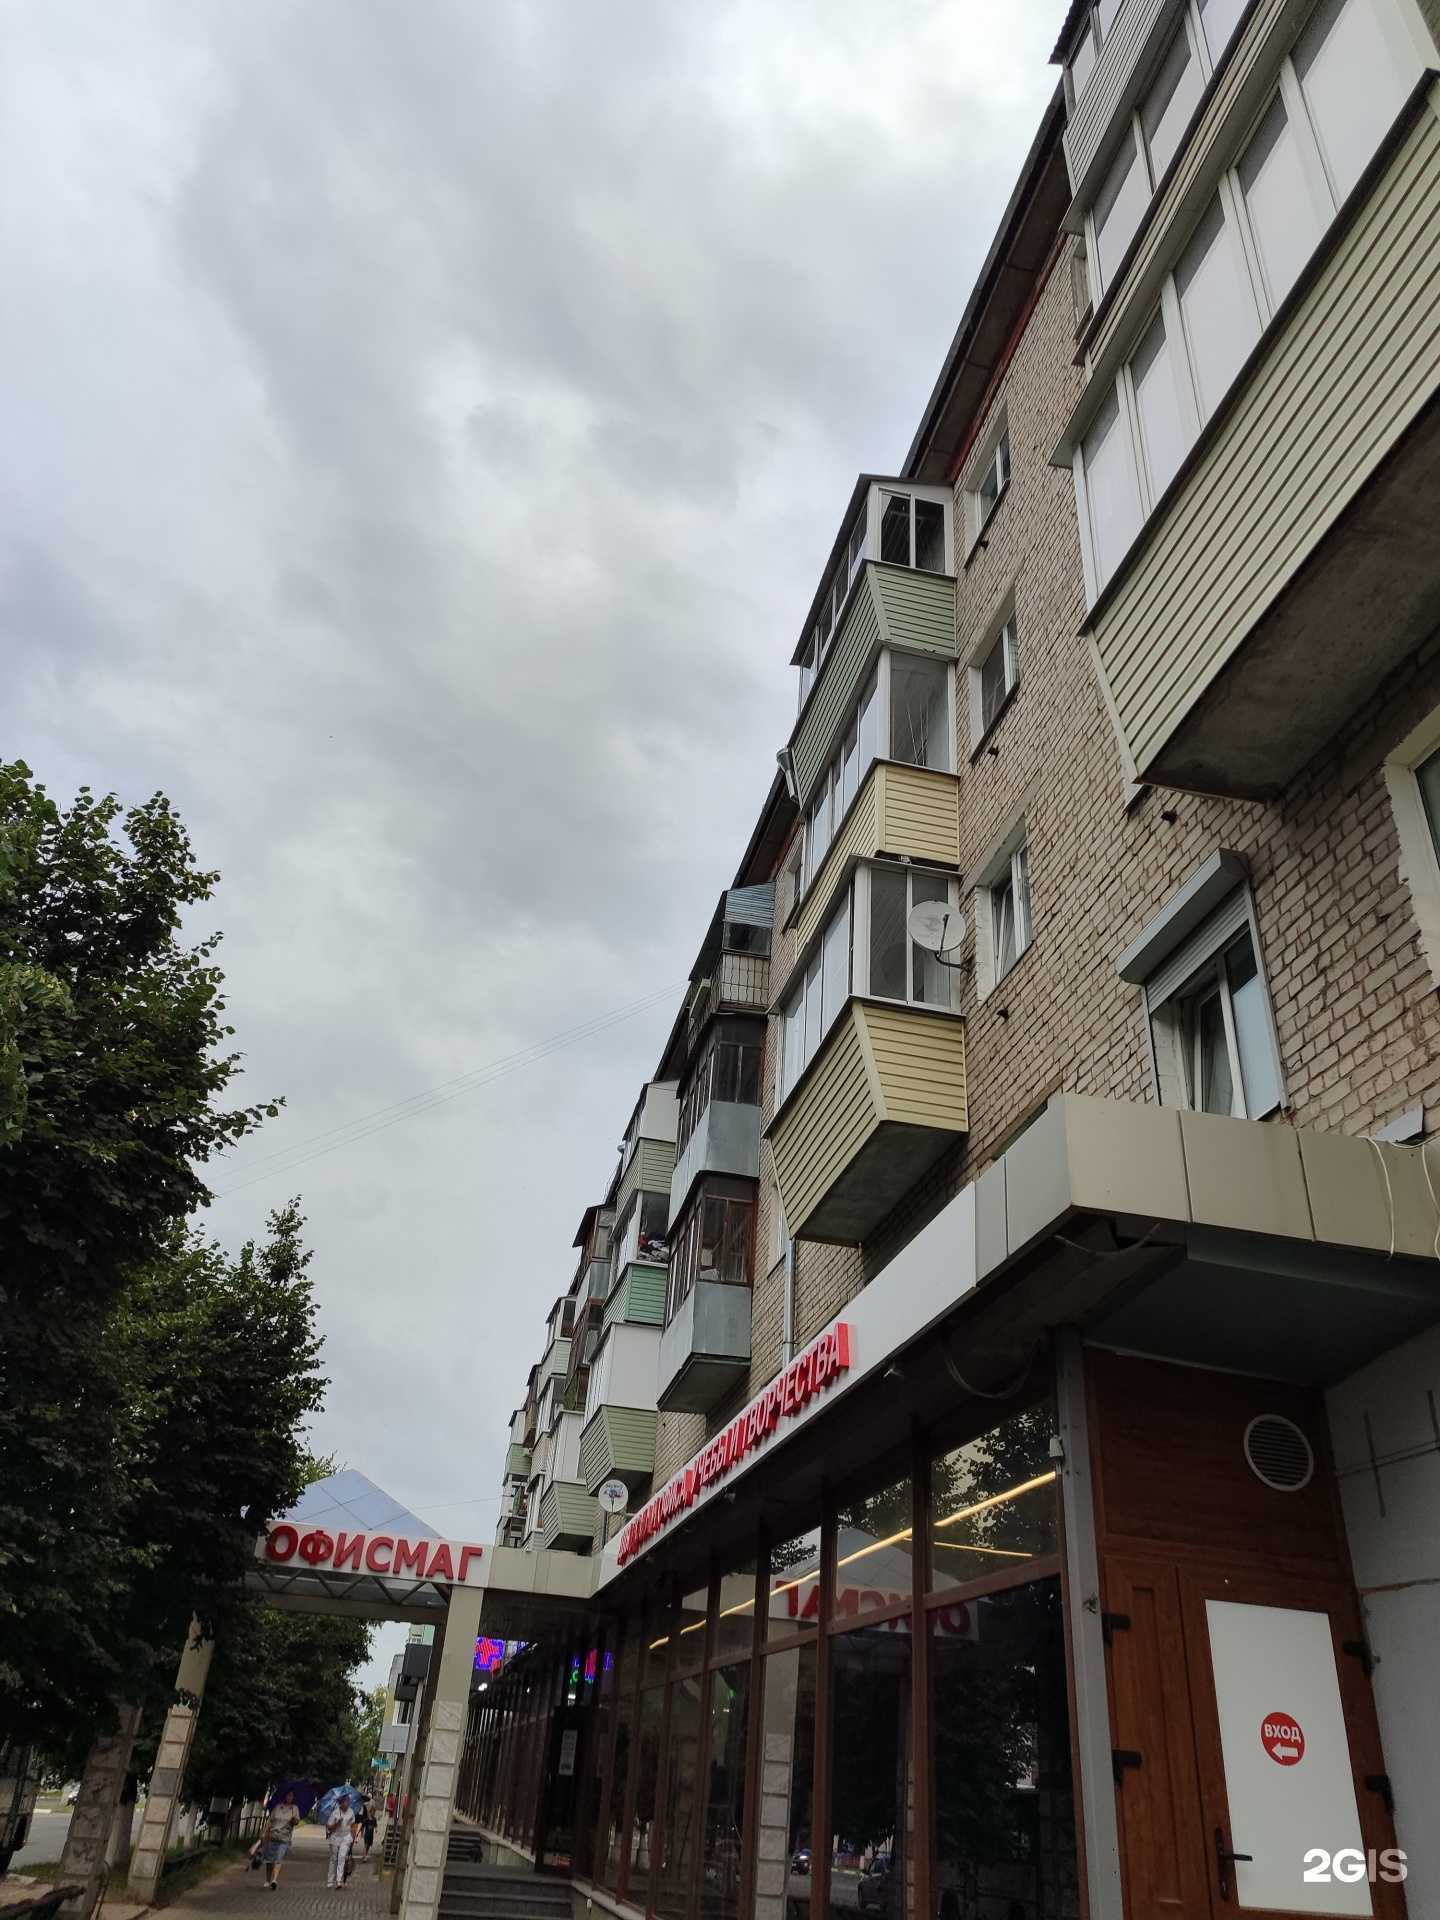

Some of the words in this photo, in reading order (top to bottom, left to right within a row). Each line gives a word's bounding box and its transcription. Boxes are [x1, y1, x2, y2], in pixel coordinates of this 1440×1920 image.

[742, 1323, 849, 1452] ТВОРЧЕСТВА
[267, 1526, 482, 1581] ОФИСМАГ
[1264, 1723, 1301, 1743] ВХОД
